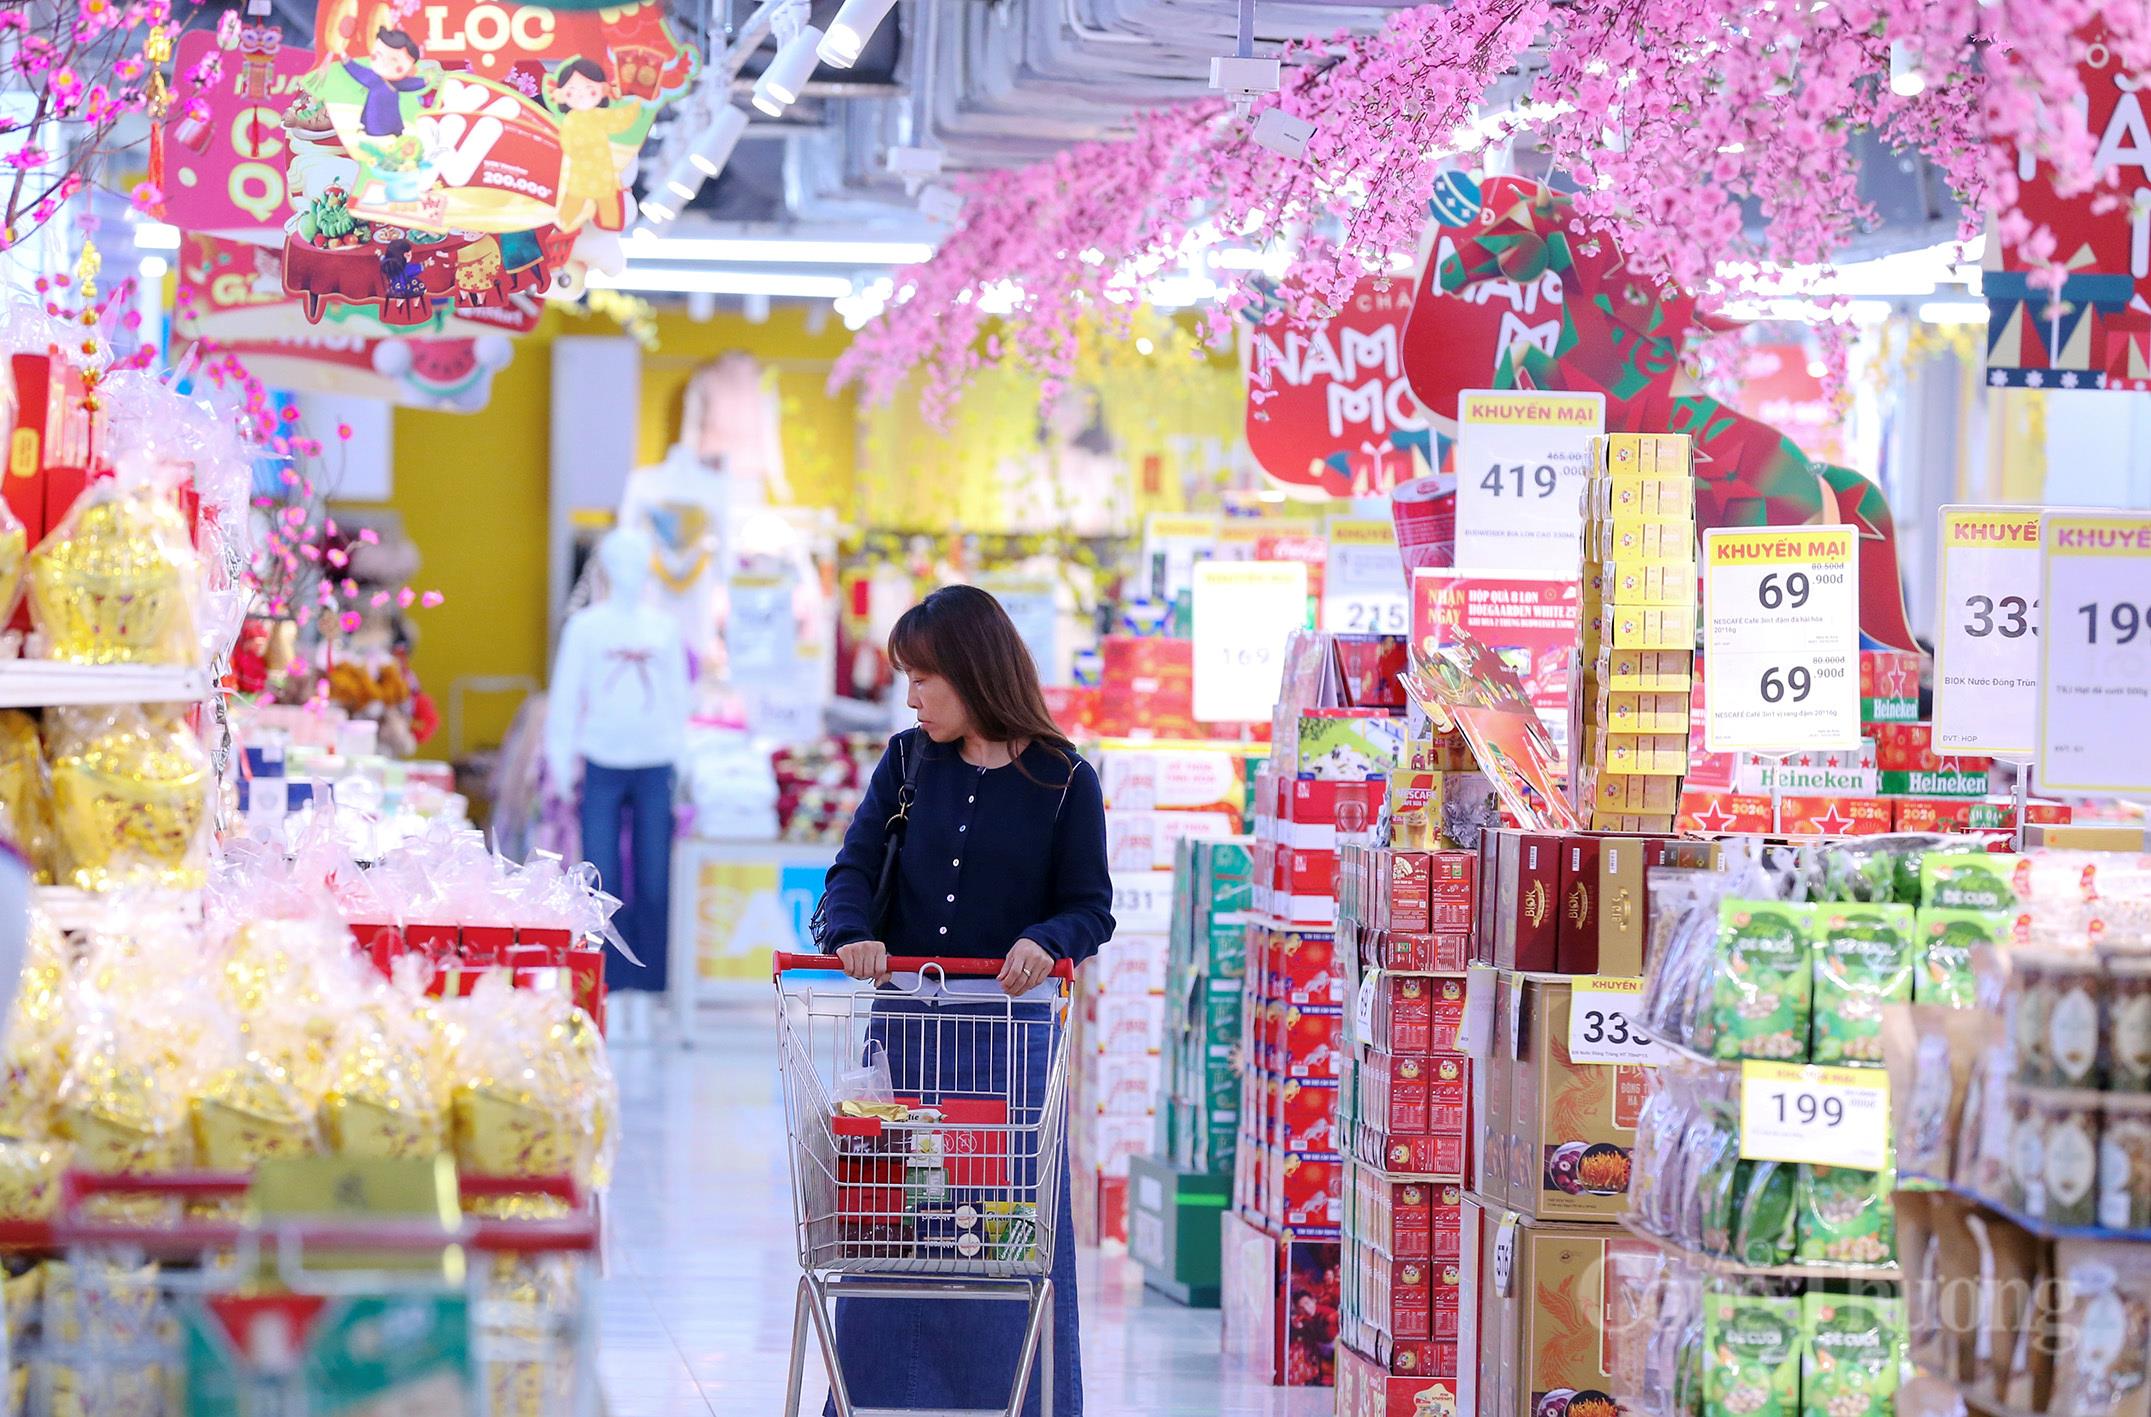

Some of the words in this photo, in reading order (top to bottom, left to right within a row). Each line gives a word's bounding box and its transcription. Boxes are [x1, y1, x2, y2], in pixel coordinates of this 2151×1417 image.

[1472, 401, 1552, 420] KHUYẾN
[1558, 406, 1593, 424] MẠI
[1480, 463, 1557, 498] 419
[1954, 520, 2039, 541] KHUYẾ
[1717, 538, 1801, 559] KHUYẾN
[1808, 541, 1845, 560] MẠI
[1759, 572, 1810, 609] 69
[1347, 602, 1405, 629] 215
[2079, 602, 2151, 645] 19
[1761, 666, 1811, 703] 69
[1874, 701, 1918, 720] Heineken
[1762, 770, 1864, 789] Heineken
[1909, 774, 1986, 793] Heineken
[1592, 980, 1637, 990] KHUYẾN
[1772, 1093, 1843, 1127] 199
